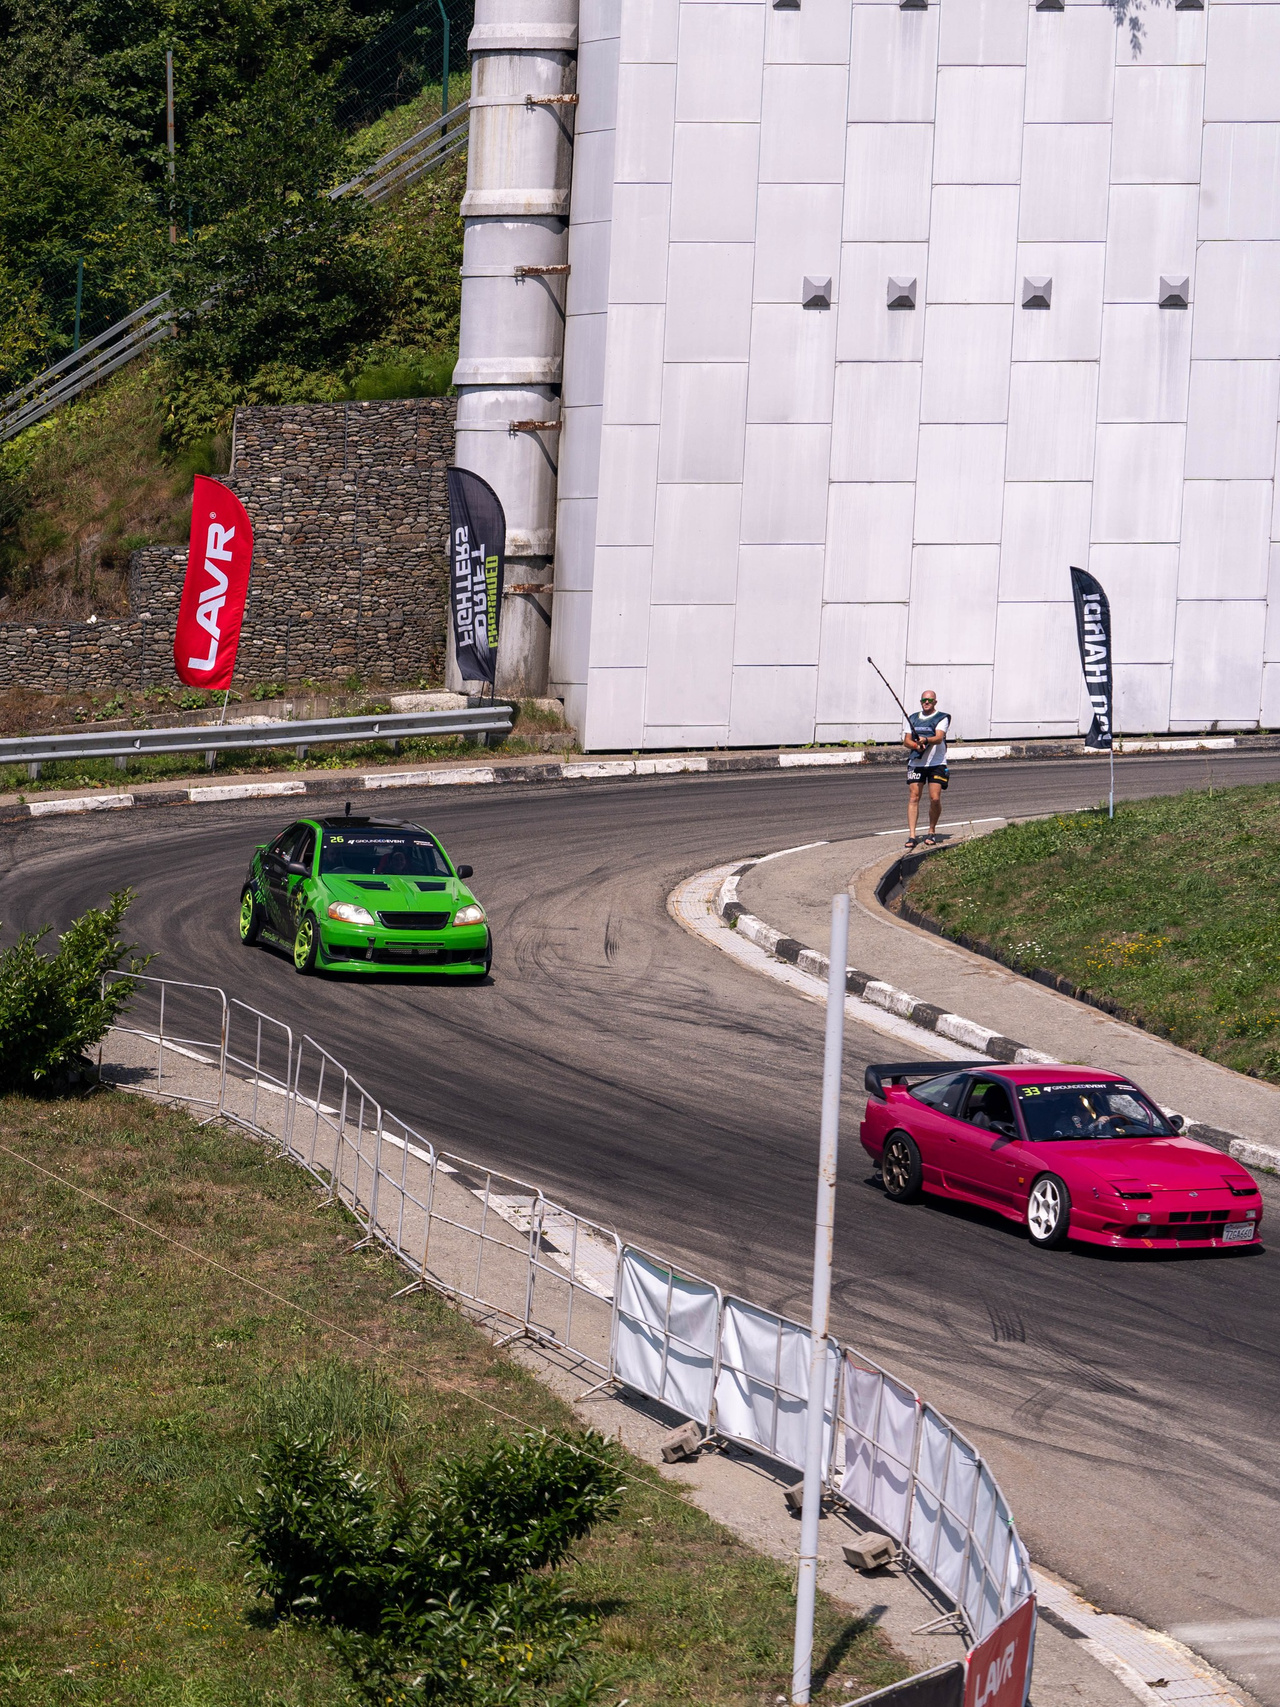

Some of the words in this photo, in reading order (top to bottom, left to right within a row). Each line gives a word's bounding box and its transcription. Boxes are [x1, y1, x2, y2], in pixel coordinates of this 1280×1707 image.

[187, 522, 236, 672] LAVR
[329, 835, 345, 844] 26
[1021, 1086, 1041, 1097] 33
[974, 1640, 1016, 1707] LAVR
